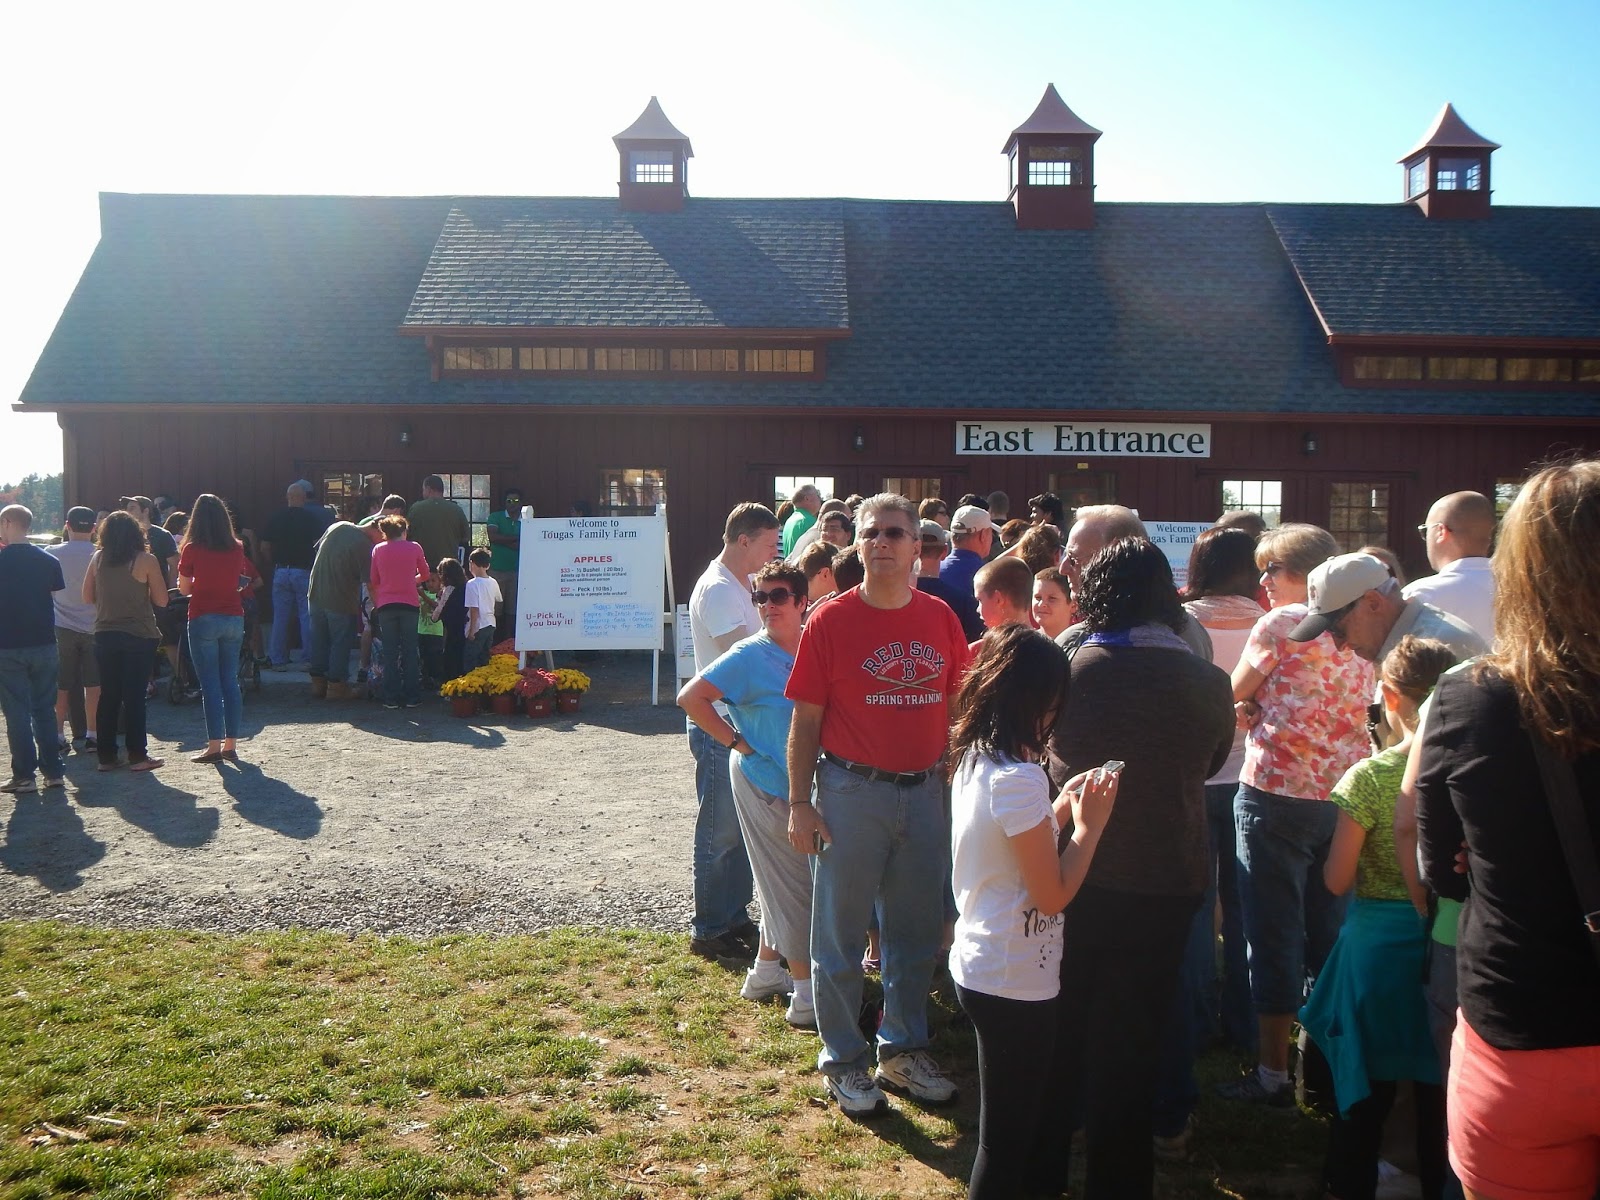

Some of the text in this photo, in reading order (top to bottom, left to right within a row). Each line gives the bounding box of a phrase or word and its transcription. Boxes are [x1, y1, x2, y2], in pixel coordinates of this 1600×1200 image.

[962, 424, 1205, 454] East Entrance
[568, 519, 620, 528] Welcome to
[1156, 524, 1209, 533] Welcome to
[541, 529, 638, 541] Tougas Family Farm
[1169, 534, 1197, 544] Famil
[573, 555, 613, 563] APPLES
[526, 611, 565, 621] U-Pick it,
[546, 619, 562, 627] buy
[862, 640, 945, 676] RED SOX
[900, 658, 917, 680] B
[915, 658, 936, 672] FLORIDA
[865, 694, 903, 705] SPRING
